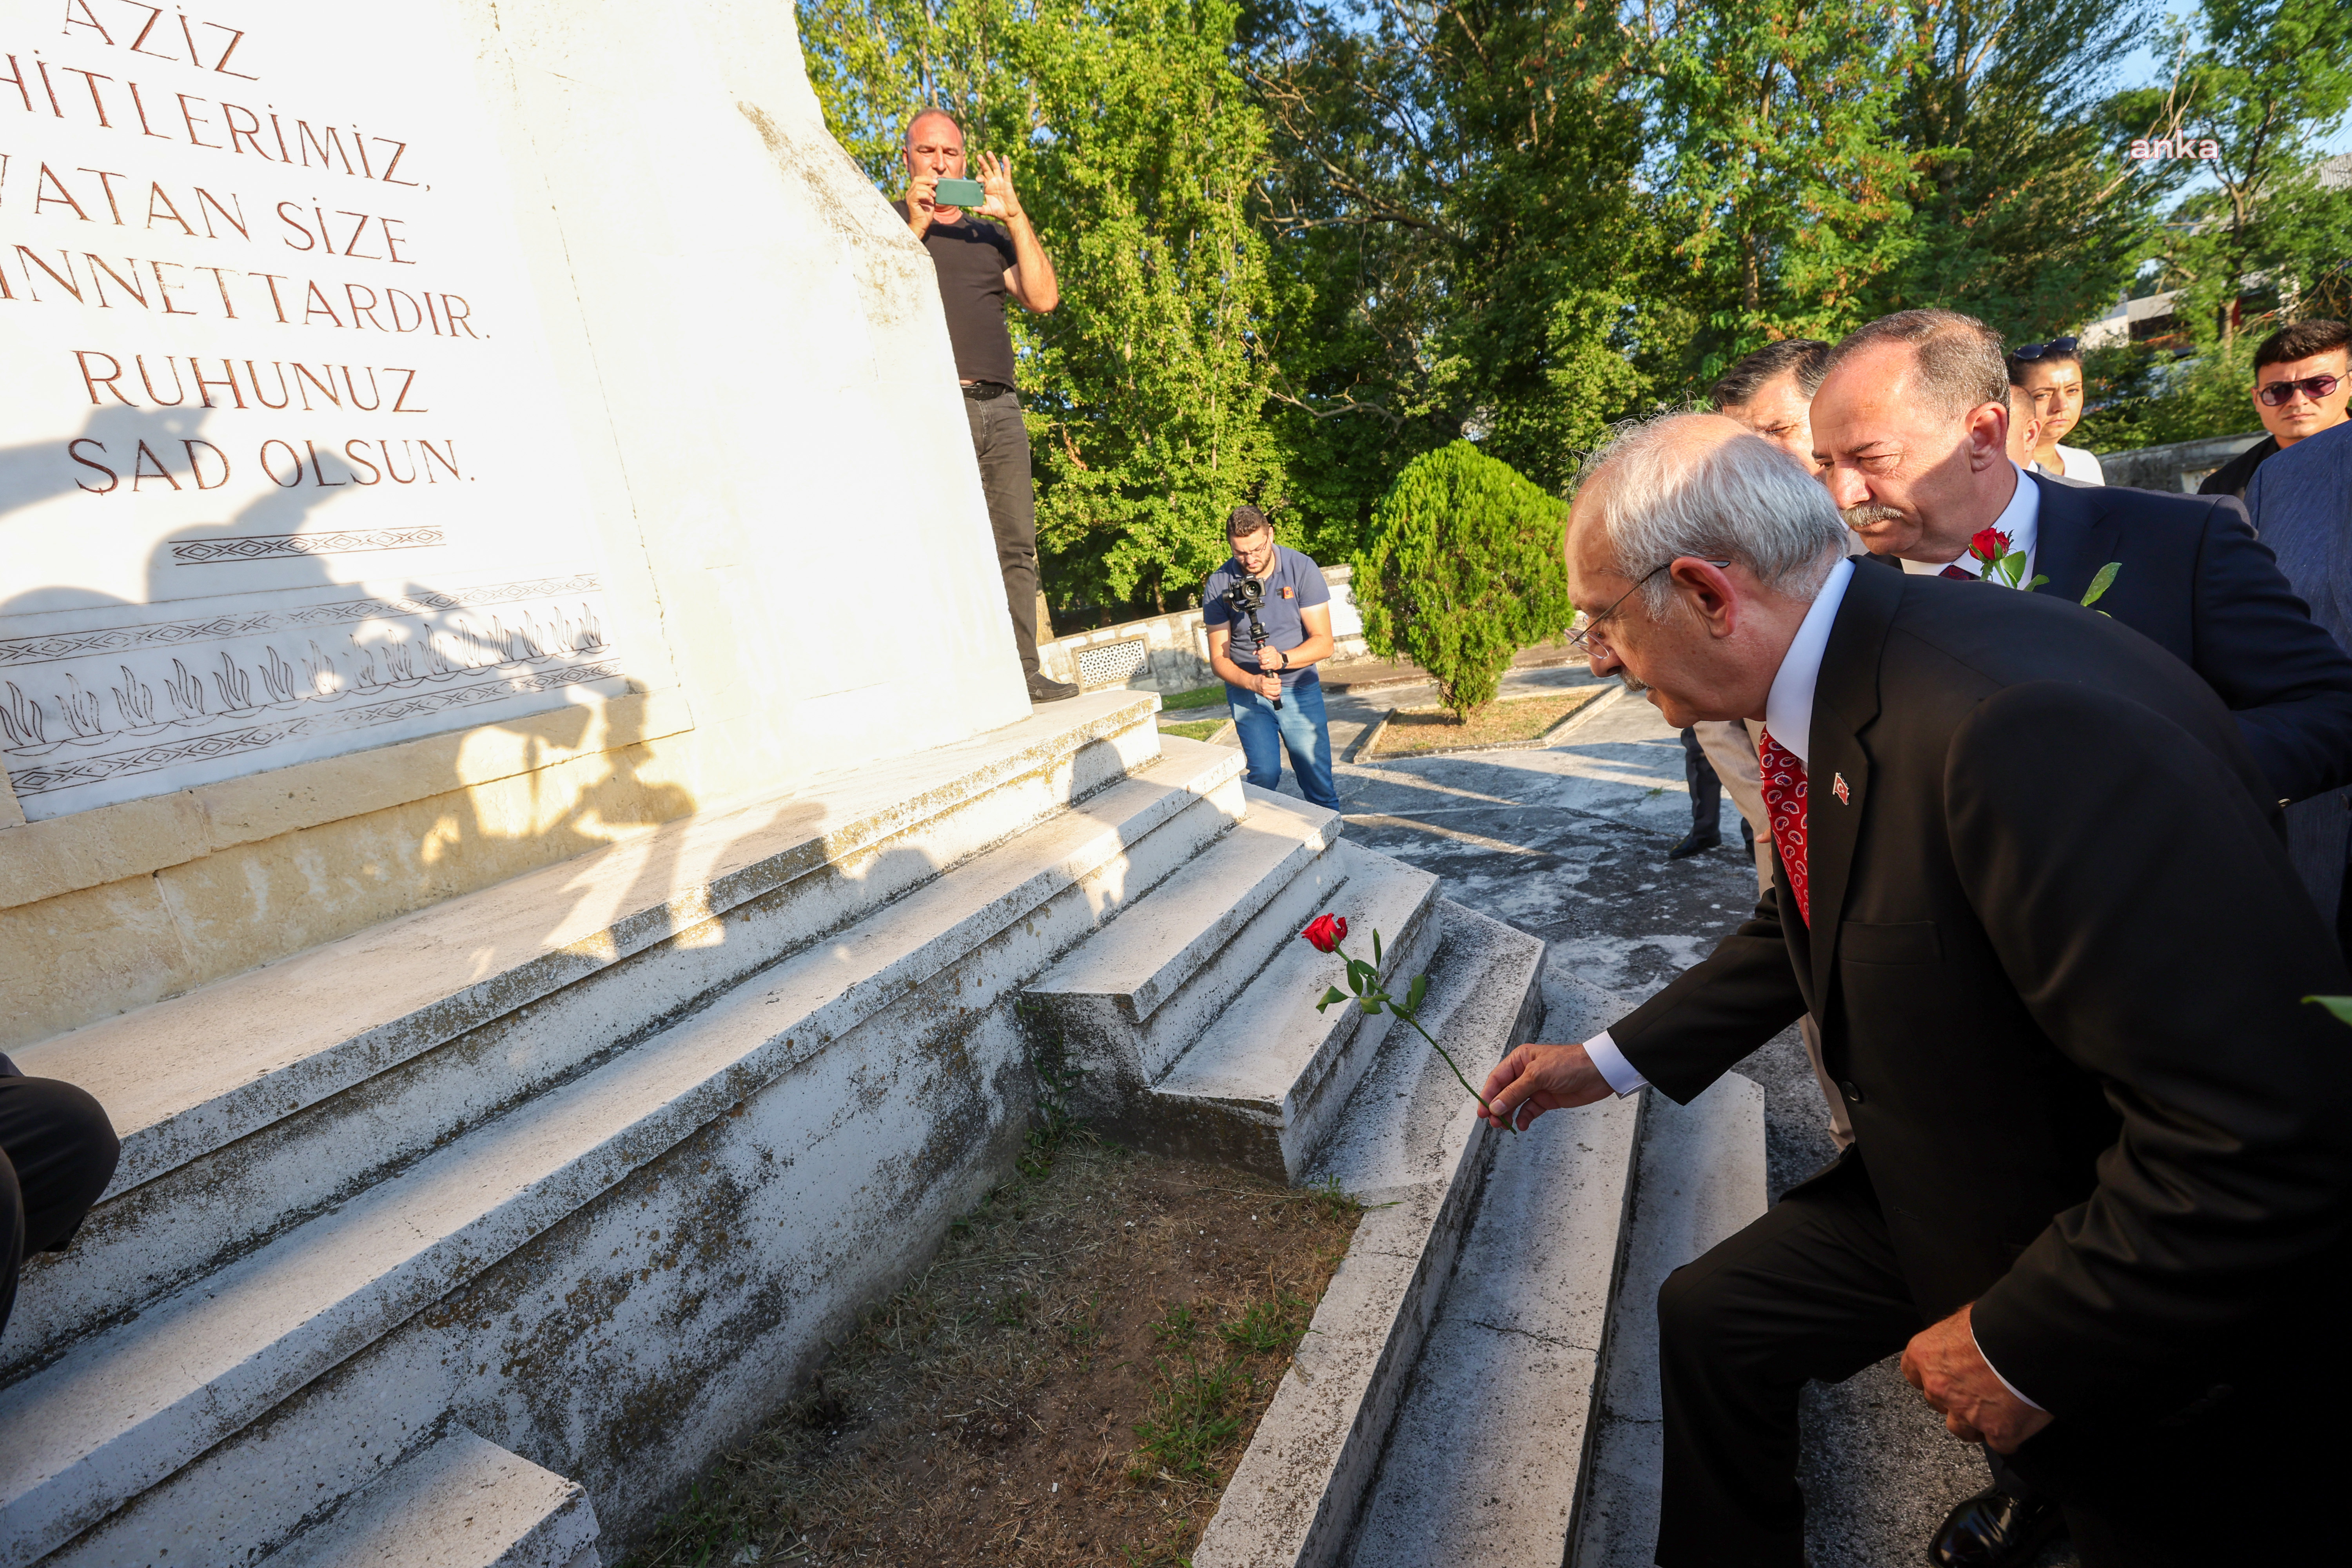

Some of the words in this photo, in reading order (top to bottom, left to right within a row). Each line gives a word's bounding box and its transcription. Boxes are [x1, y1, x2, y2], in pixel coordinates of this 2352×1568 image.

[62, 0, 260, 81] AZİZ
[0, 154, 250, 241] ATAN
[277, 197, 416, 265] SİZE
[70, 350, 428, 413] RUHUNUZ
[260, 439, 475, 488] OLSUN.
